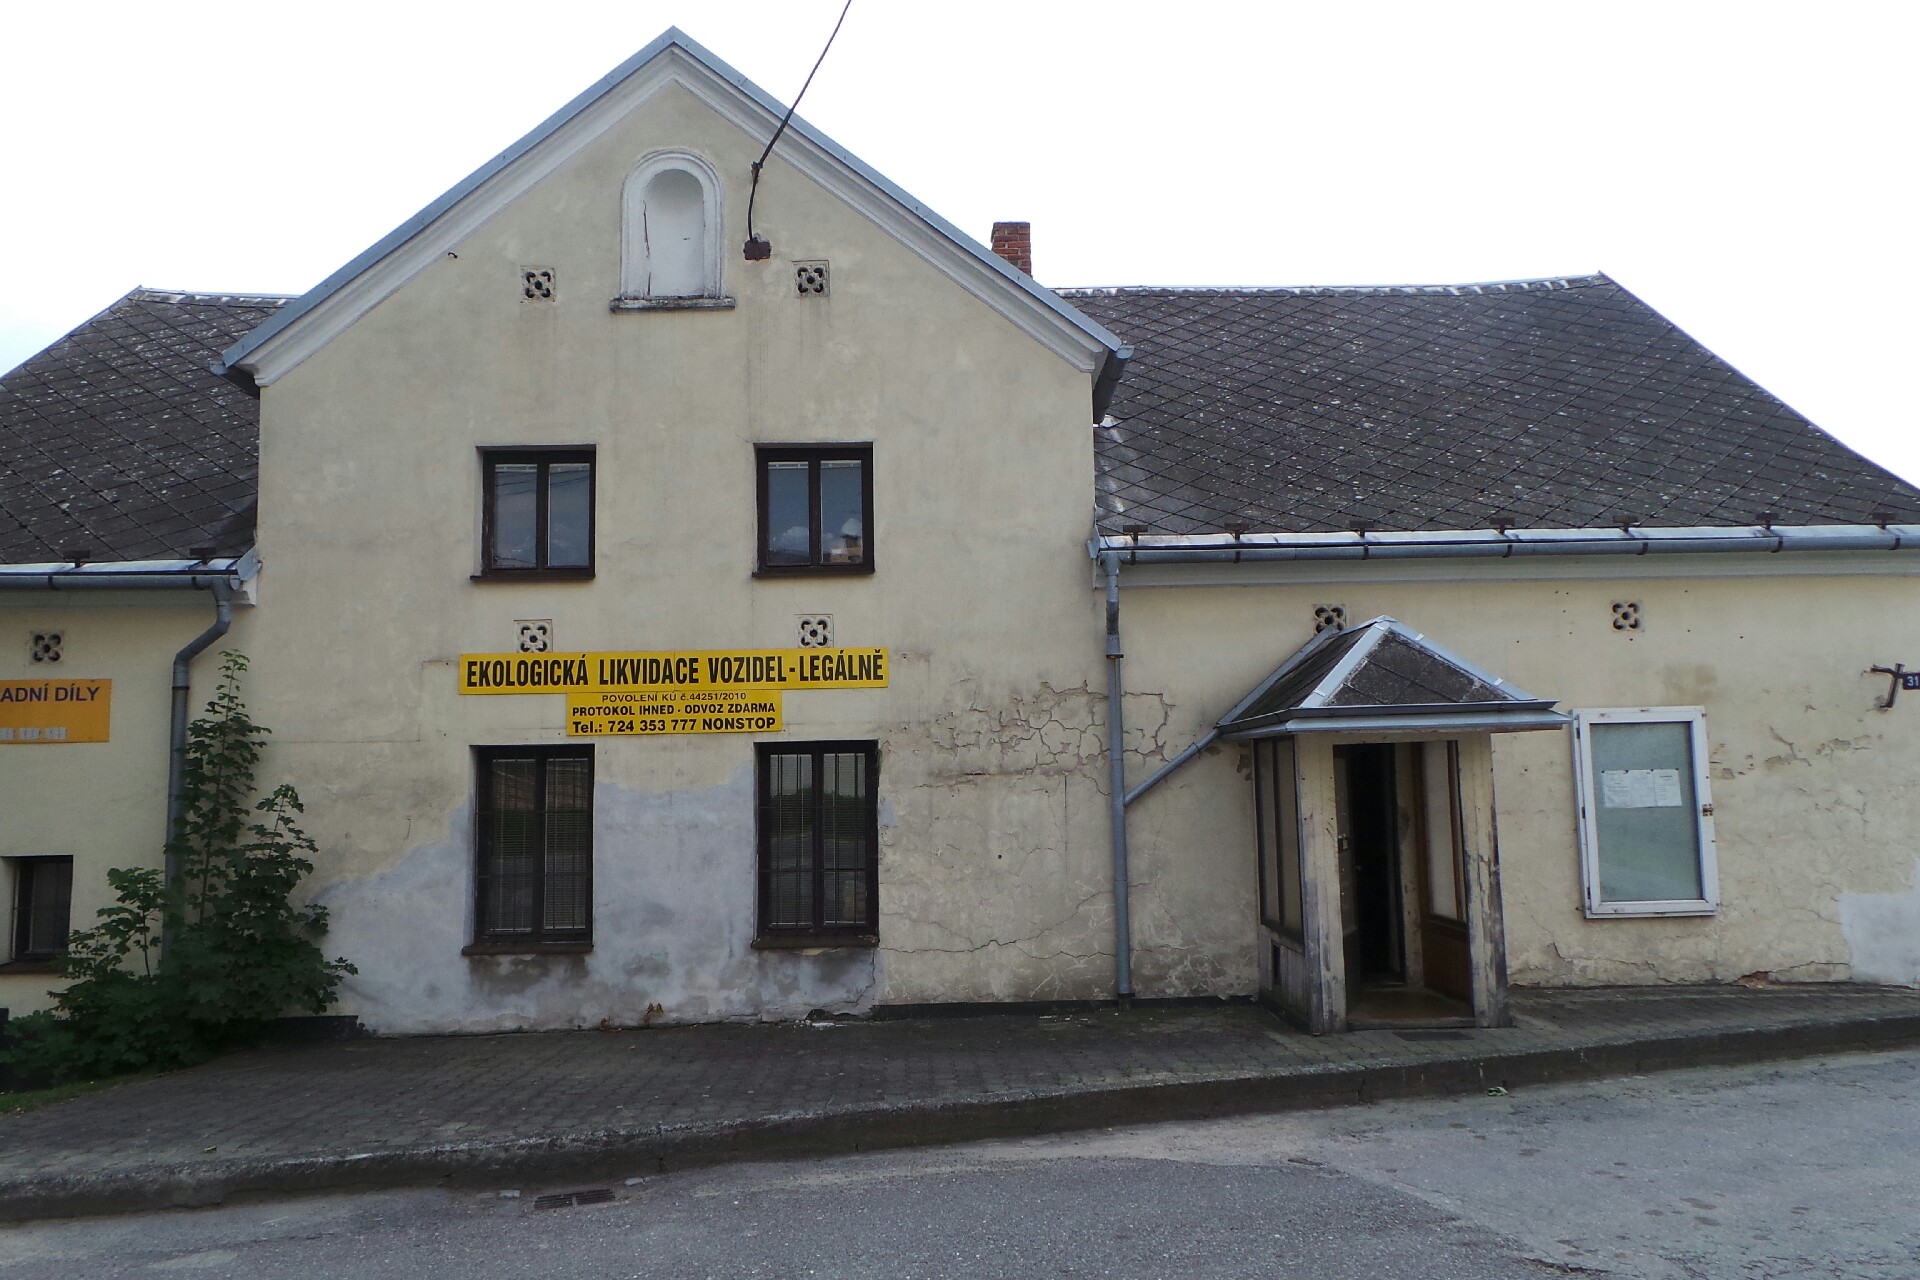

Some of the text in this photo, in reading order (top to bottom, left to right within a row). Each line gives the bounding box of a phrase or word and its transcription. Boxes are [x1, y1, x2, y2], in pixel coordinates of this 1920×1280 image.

[467, 654, 589, 687] EKOLOGICKÁ
[600, 657, 699, 685] LIKVIDACE
[799, 649, 884, 682] LEGÁLNĚ
[55, 683, 100, 702] DÍLY
[602, 691, 658, 703] POVOLENÍ
[662, 691, 677, 701] KÚ
[572, 706, 636, 717] PROTOKOL
[639, 705, 675, 715] IHNED
[684, 703, 724, 714] ODVOZ
[727, 703, 776, 713] ZDARMA
[572, 717, 776, 734] Tel.: 724 353 777 NONSTOP
